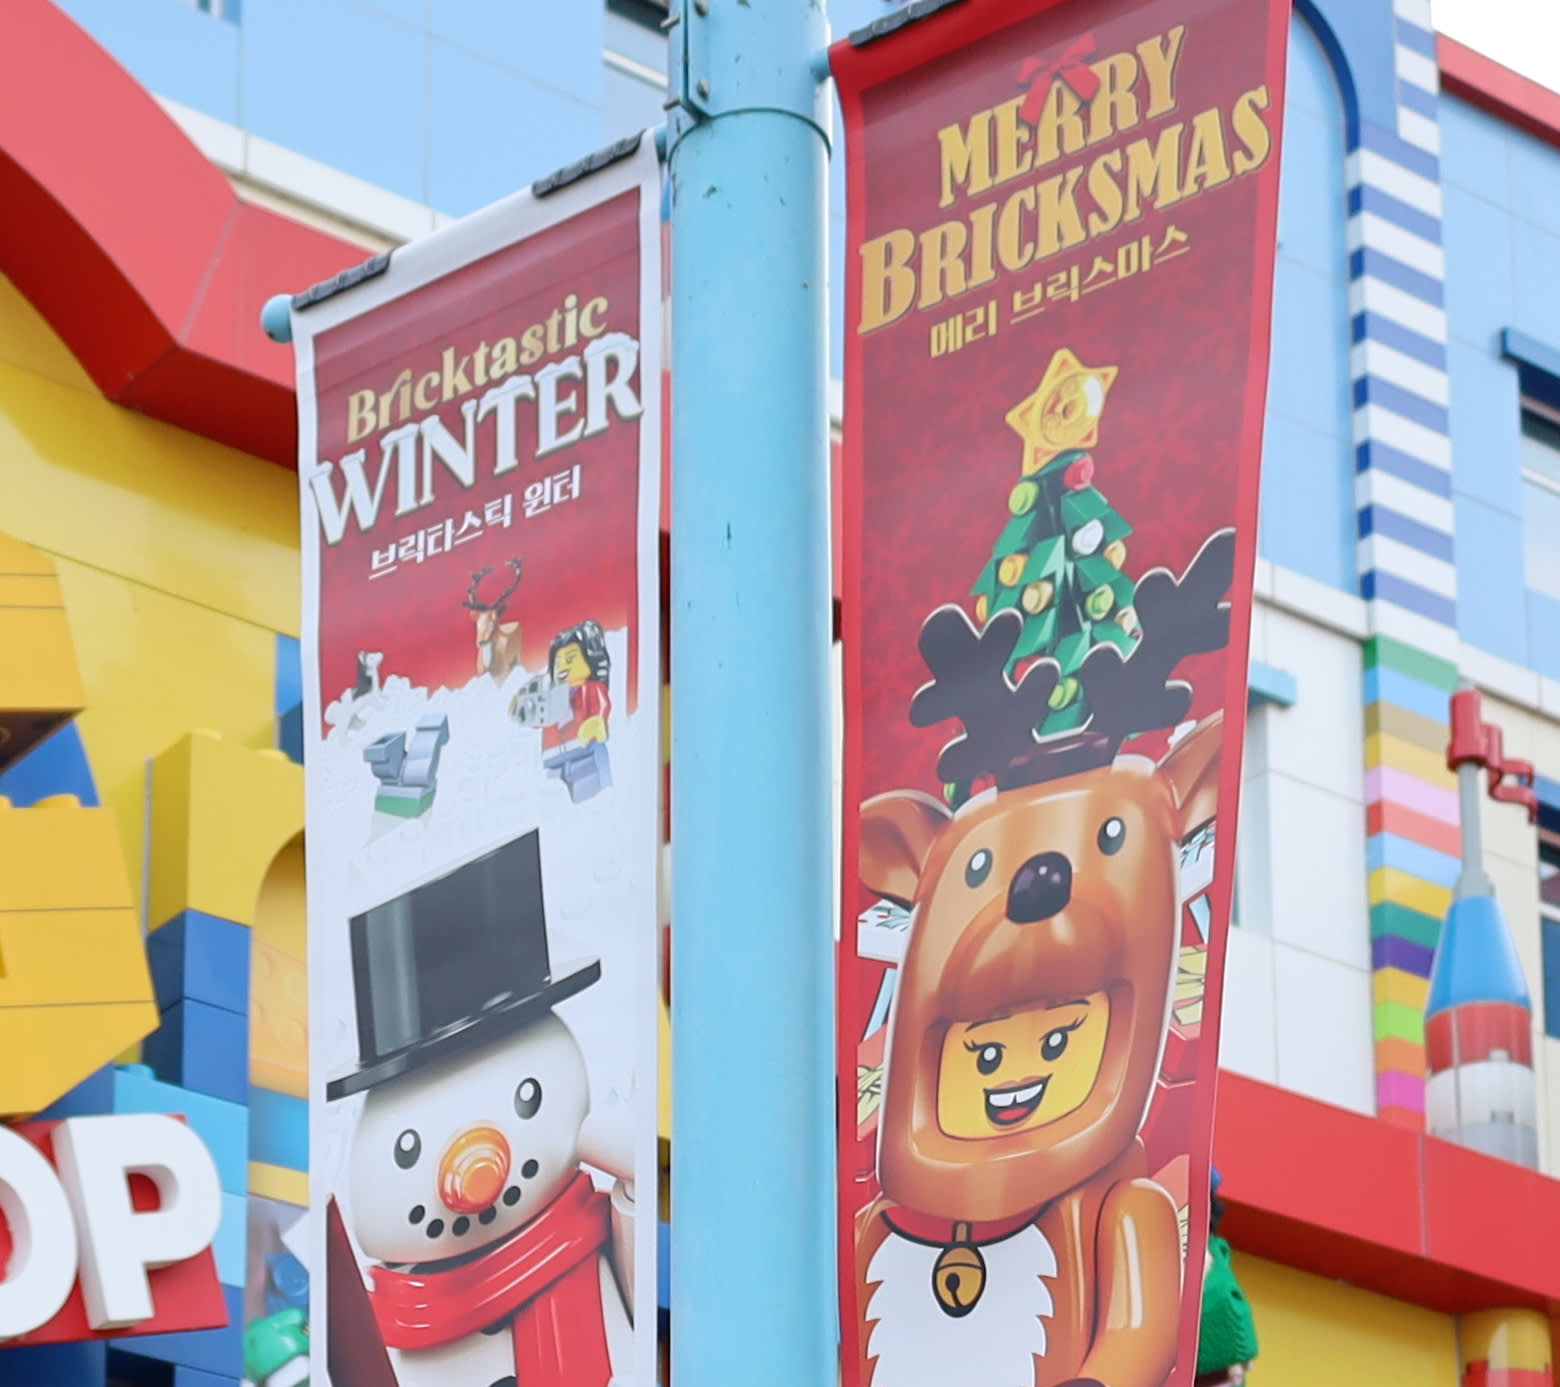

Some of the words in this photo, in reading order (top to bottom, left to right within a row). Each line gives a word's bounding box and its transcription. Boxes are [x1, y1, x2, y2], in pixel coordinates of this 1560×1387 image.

[938, 25, 1185, 208] MERRY
[857, 84, 1271, 335] BRICKSMAS
[930, 300, 997, 358] 메리
[1010, 224, 1192, 324] 브릭스마스
[309, 332, 644, 546] WINTER
[346, 293, 609, 444] Bricktastic
[368, 494, 513, 580] 브릭타스틱
[523, 464, 581, 518] 윈터
